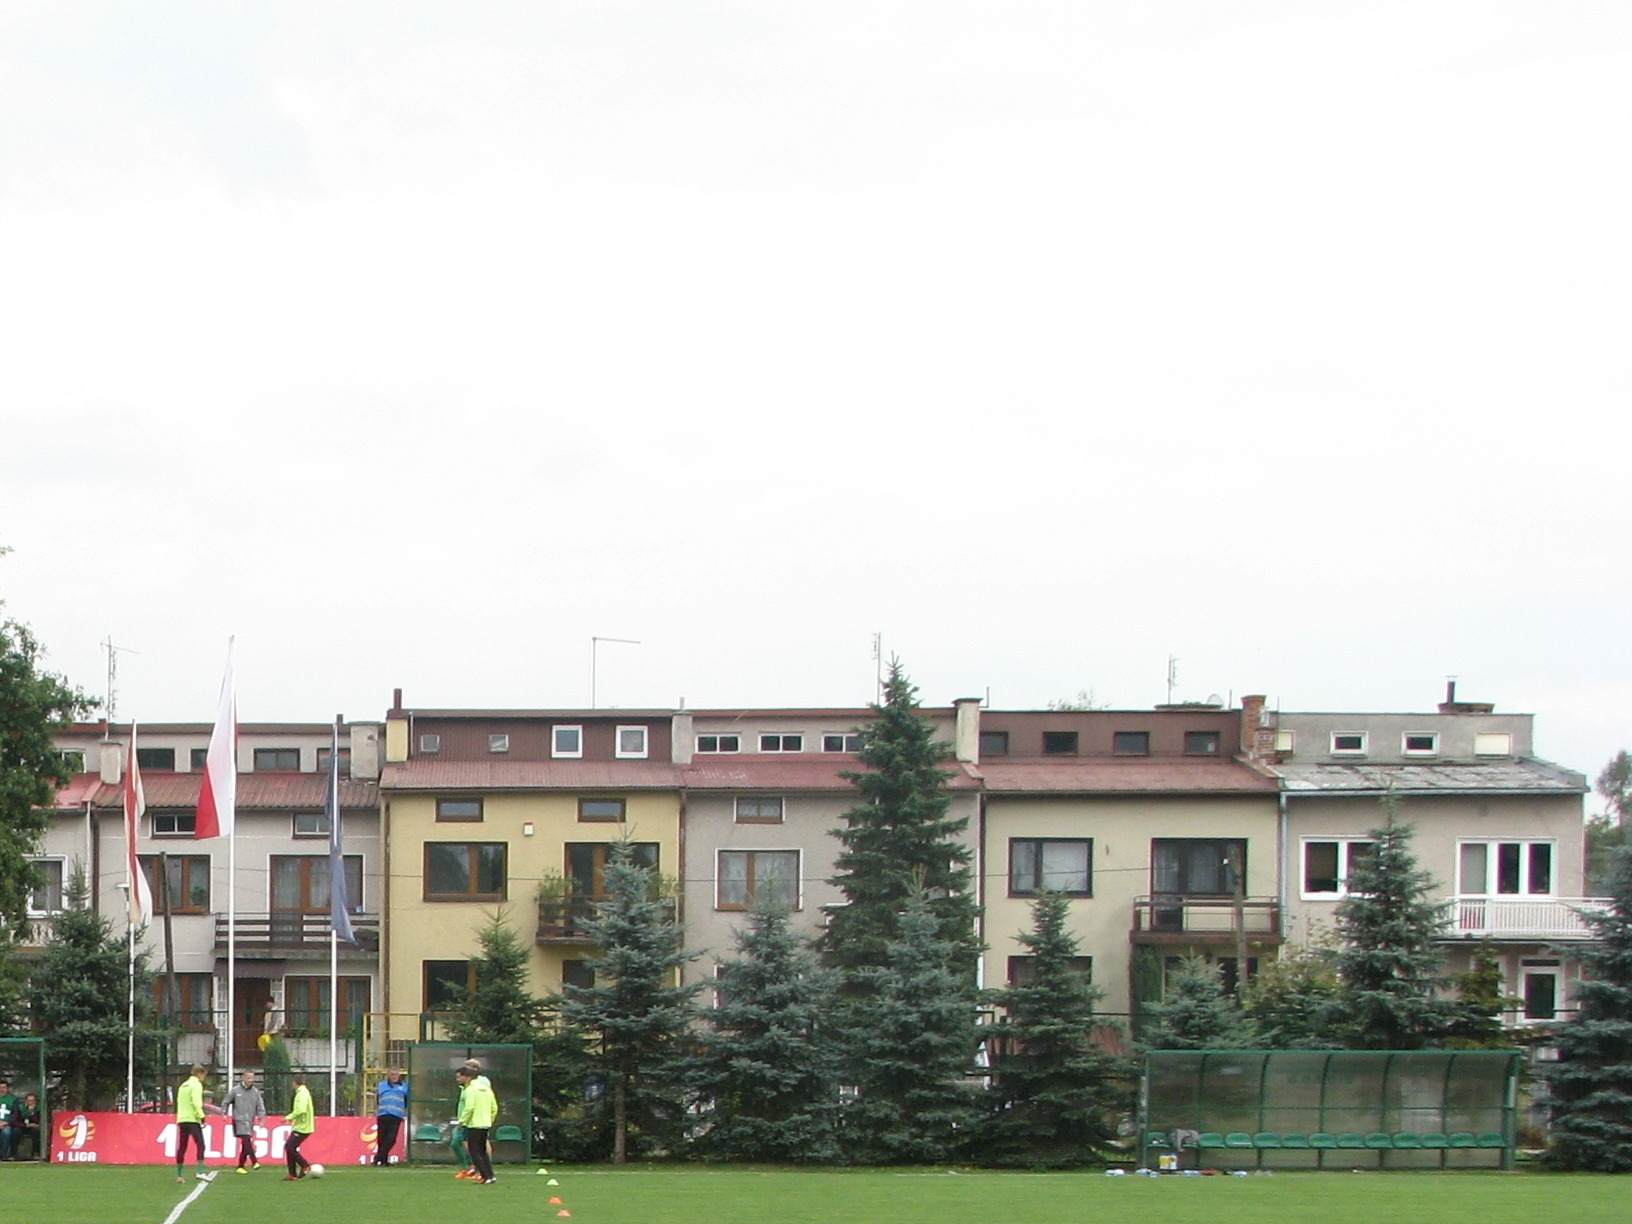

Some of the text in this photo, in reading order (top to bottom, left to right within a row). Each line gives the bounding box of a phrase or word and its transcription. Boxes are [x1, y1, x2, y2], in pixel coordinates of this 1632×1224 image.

[156, 1123, 178, 1158] 1
[57, 1151, 97, 1162] 1 LIGA
